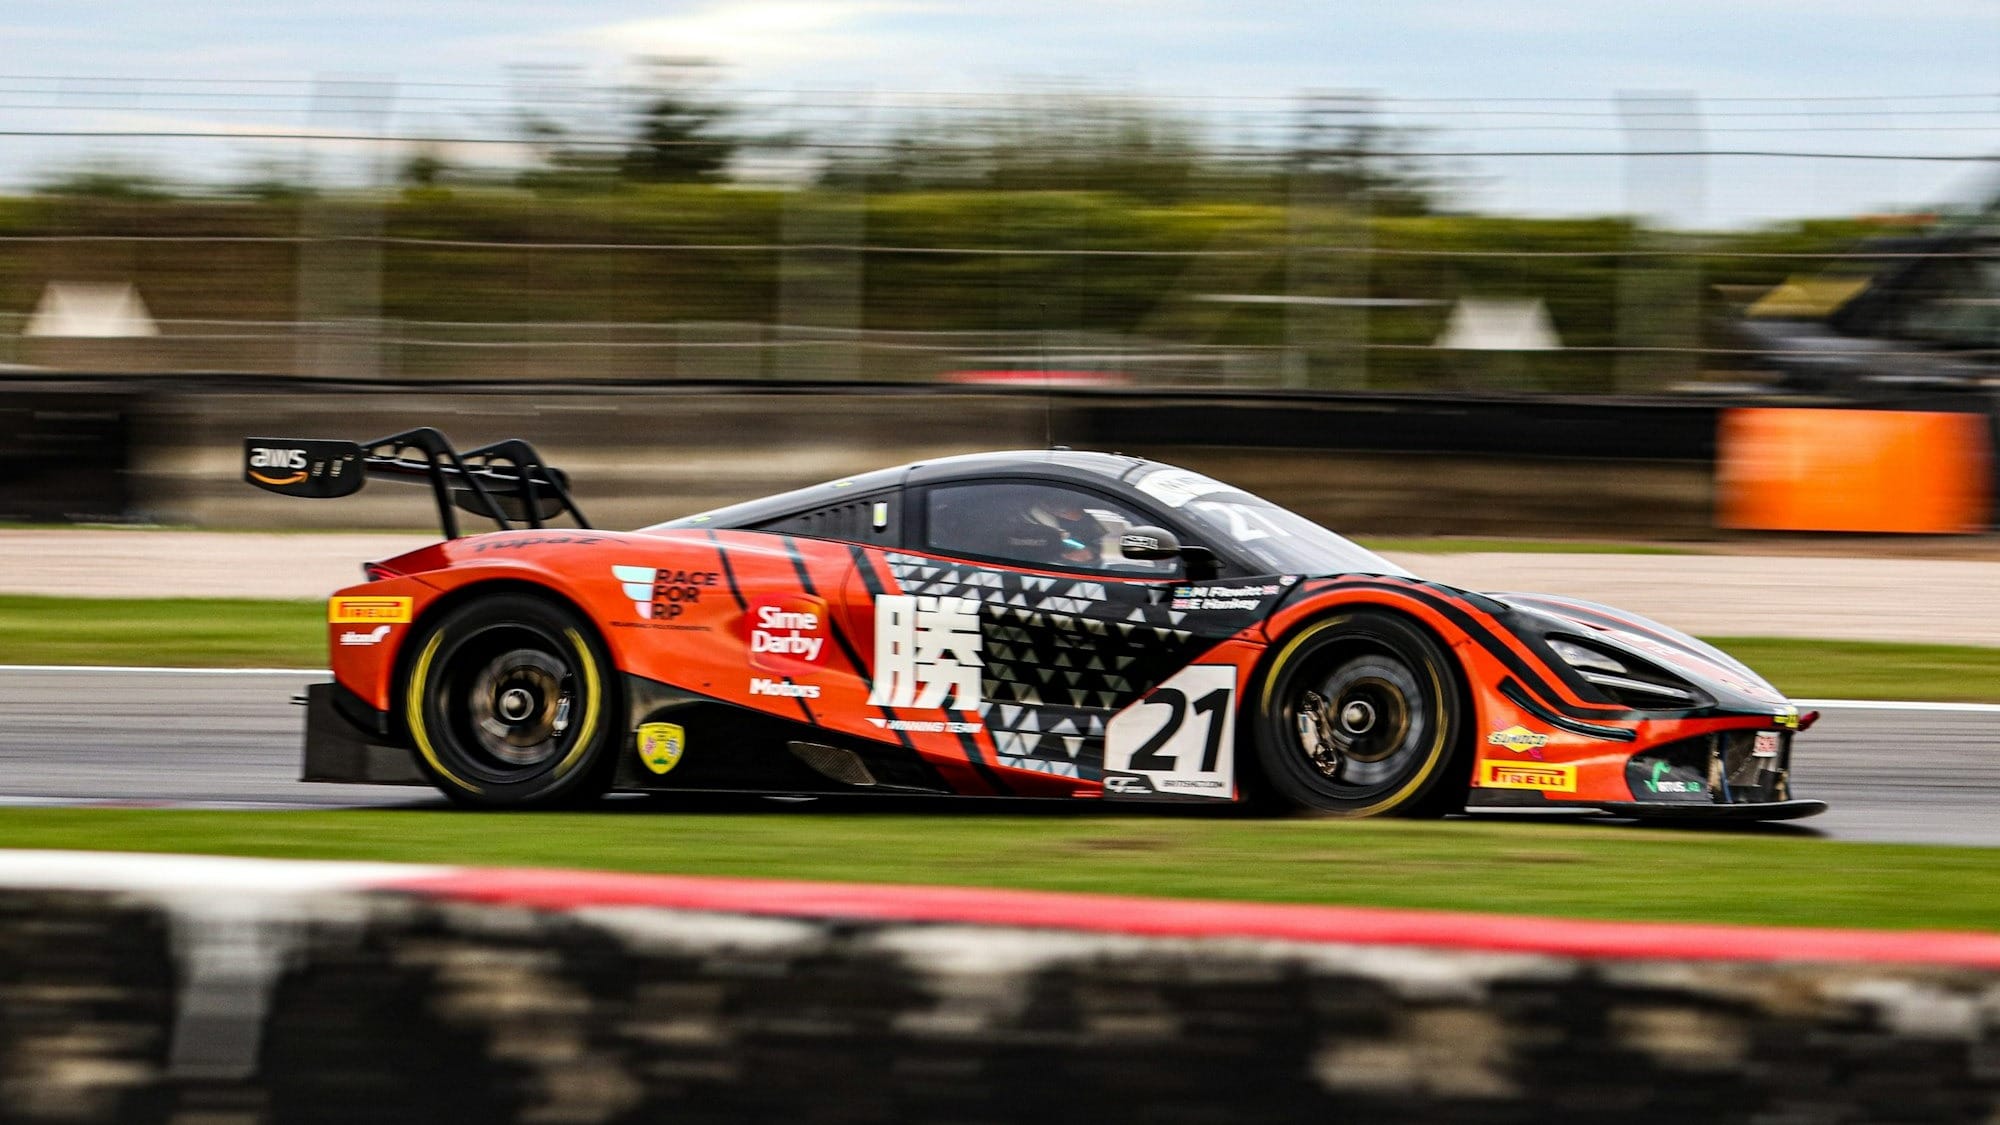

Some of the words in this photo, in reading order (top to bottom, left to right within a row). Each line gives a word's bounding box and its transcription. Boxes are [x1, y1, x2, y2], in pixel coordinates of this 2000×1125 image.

[250, 447, 307, 469] aws
[1192, 501, 1291, 541] 21
[656, 569, 720, 586] RACE
[655, 586, 700, 603] FOR
[653, 604, 684, 620] RP
[757, 606, 818, 629] Sime
[751, 630, 823, 661] Darby
[867, 595, 984, 710] 勝
[749, 678, 820, 698] Motors
[886, 719, 946, 732] WINNING
[944, 721, 983, 733] TEAM
[1129, 687, 1235, 773] 21
[1490, 732, 1548, 747] SUNOCO
[1490, 766, 1566, 787] PIRELLI
